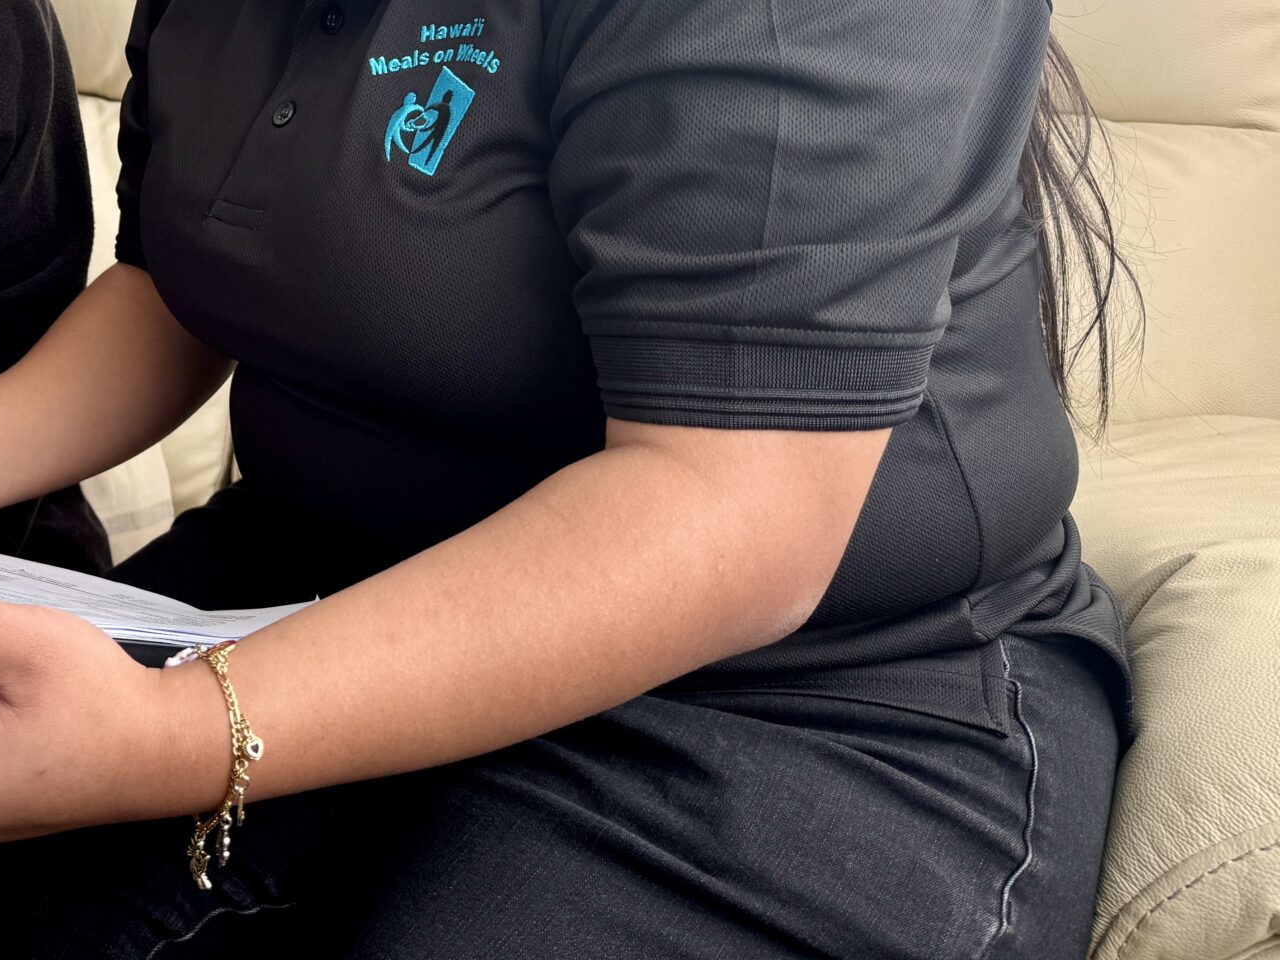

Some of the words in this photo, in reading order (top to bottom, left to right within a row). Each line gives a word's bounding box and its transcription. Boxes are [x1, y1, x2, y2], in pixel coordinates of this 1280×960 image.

[368, 49, 430, 75] Meals
[433, 48, 454, 63] on
[455, 43, 501, 74] Wheels
